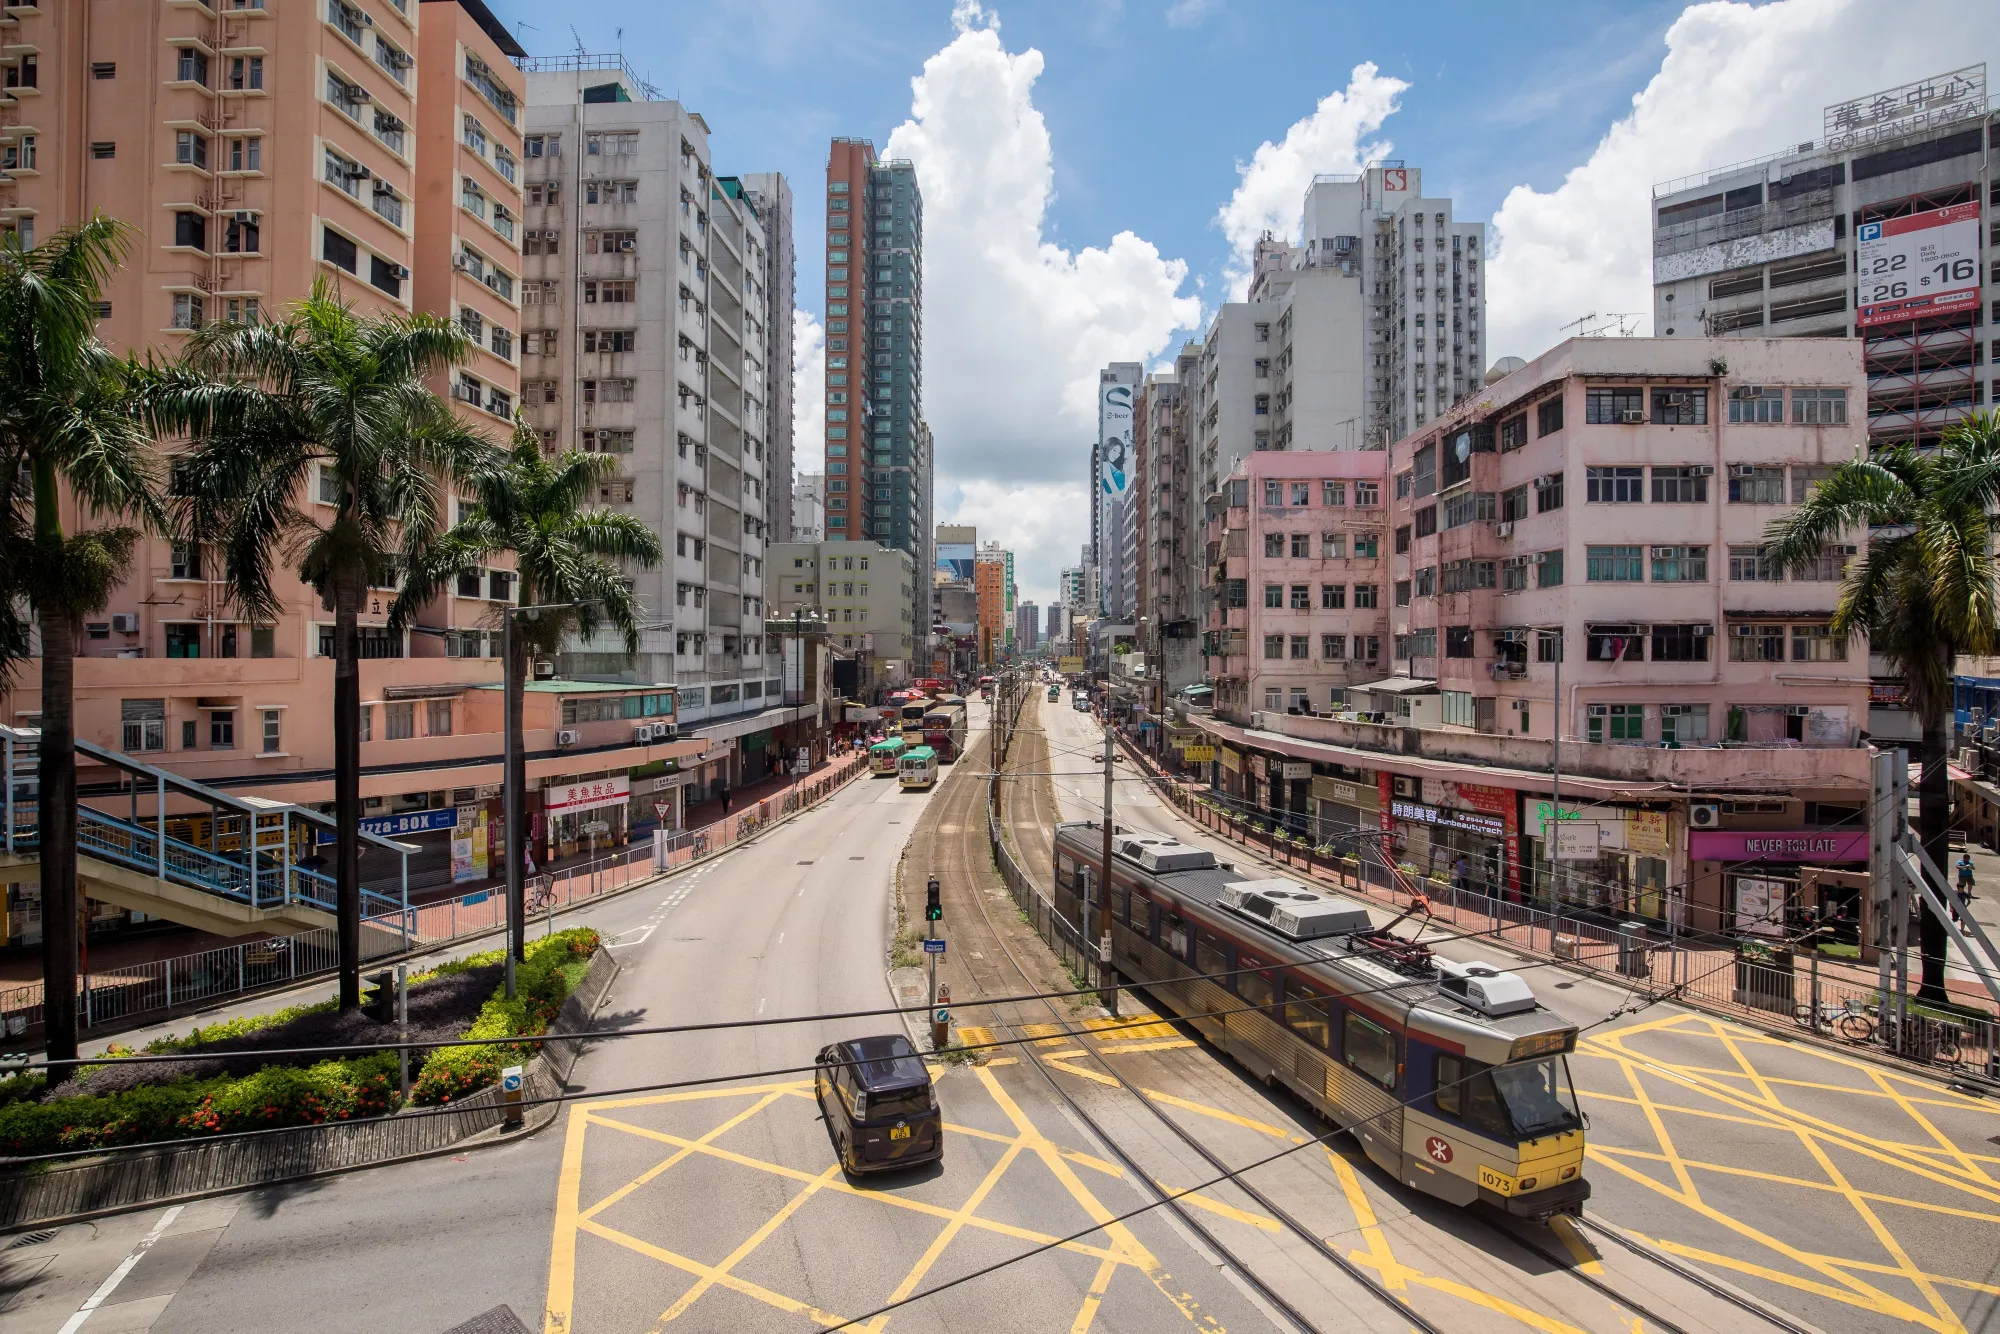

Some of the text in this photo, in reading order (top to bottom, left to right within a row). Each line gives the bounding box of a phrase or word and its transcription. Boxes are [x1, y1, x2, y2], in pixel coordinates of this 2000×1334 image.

[1833, 75, 1976, 131] 萬金中心
[1828, 101, 1978, 151] GOLDEN PLAZA
[1872, 254, 1907, 275] 22
[1932, 258, 1974, 284] 16
[1873, 281, 1908, 302] 26
[1269, 758, 1282, 774] BAR
[566, 782, 615, 801] 美魚妝品
[1392, 802, 1438, 823] 詩朗美容
[1746, 839, 1837, 852] NEVER TOO LATE
[1481, 1171, 1510, 1193] 1073
